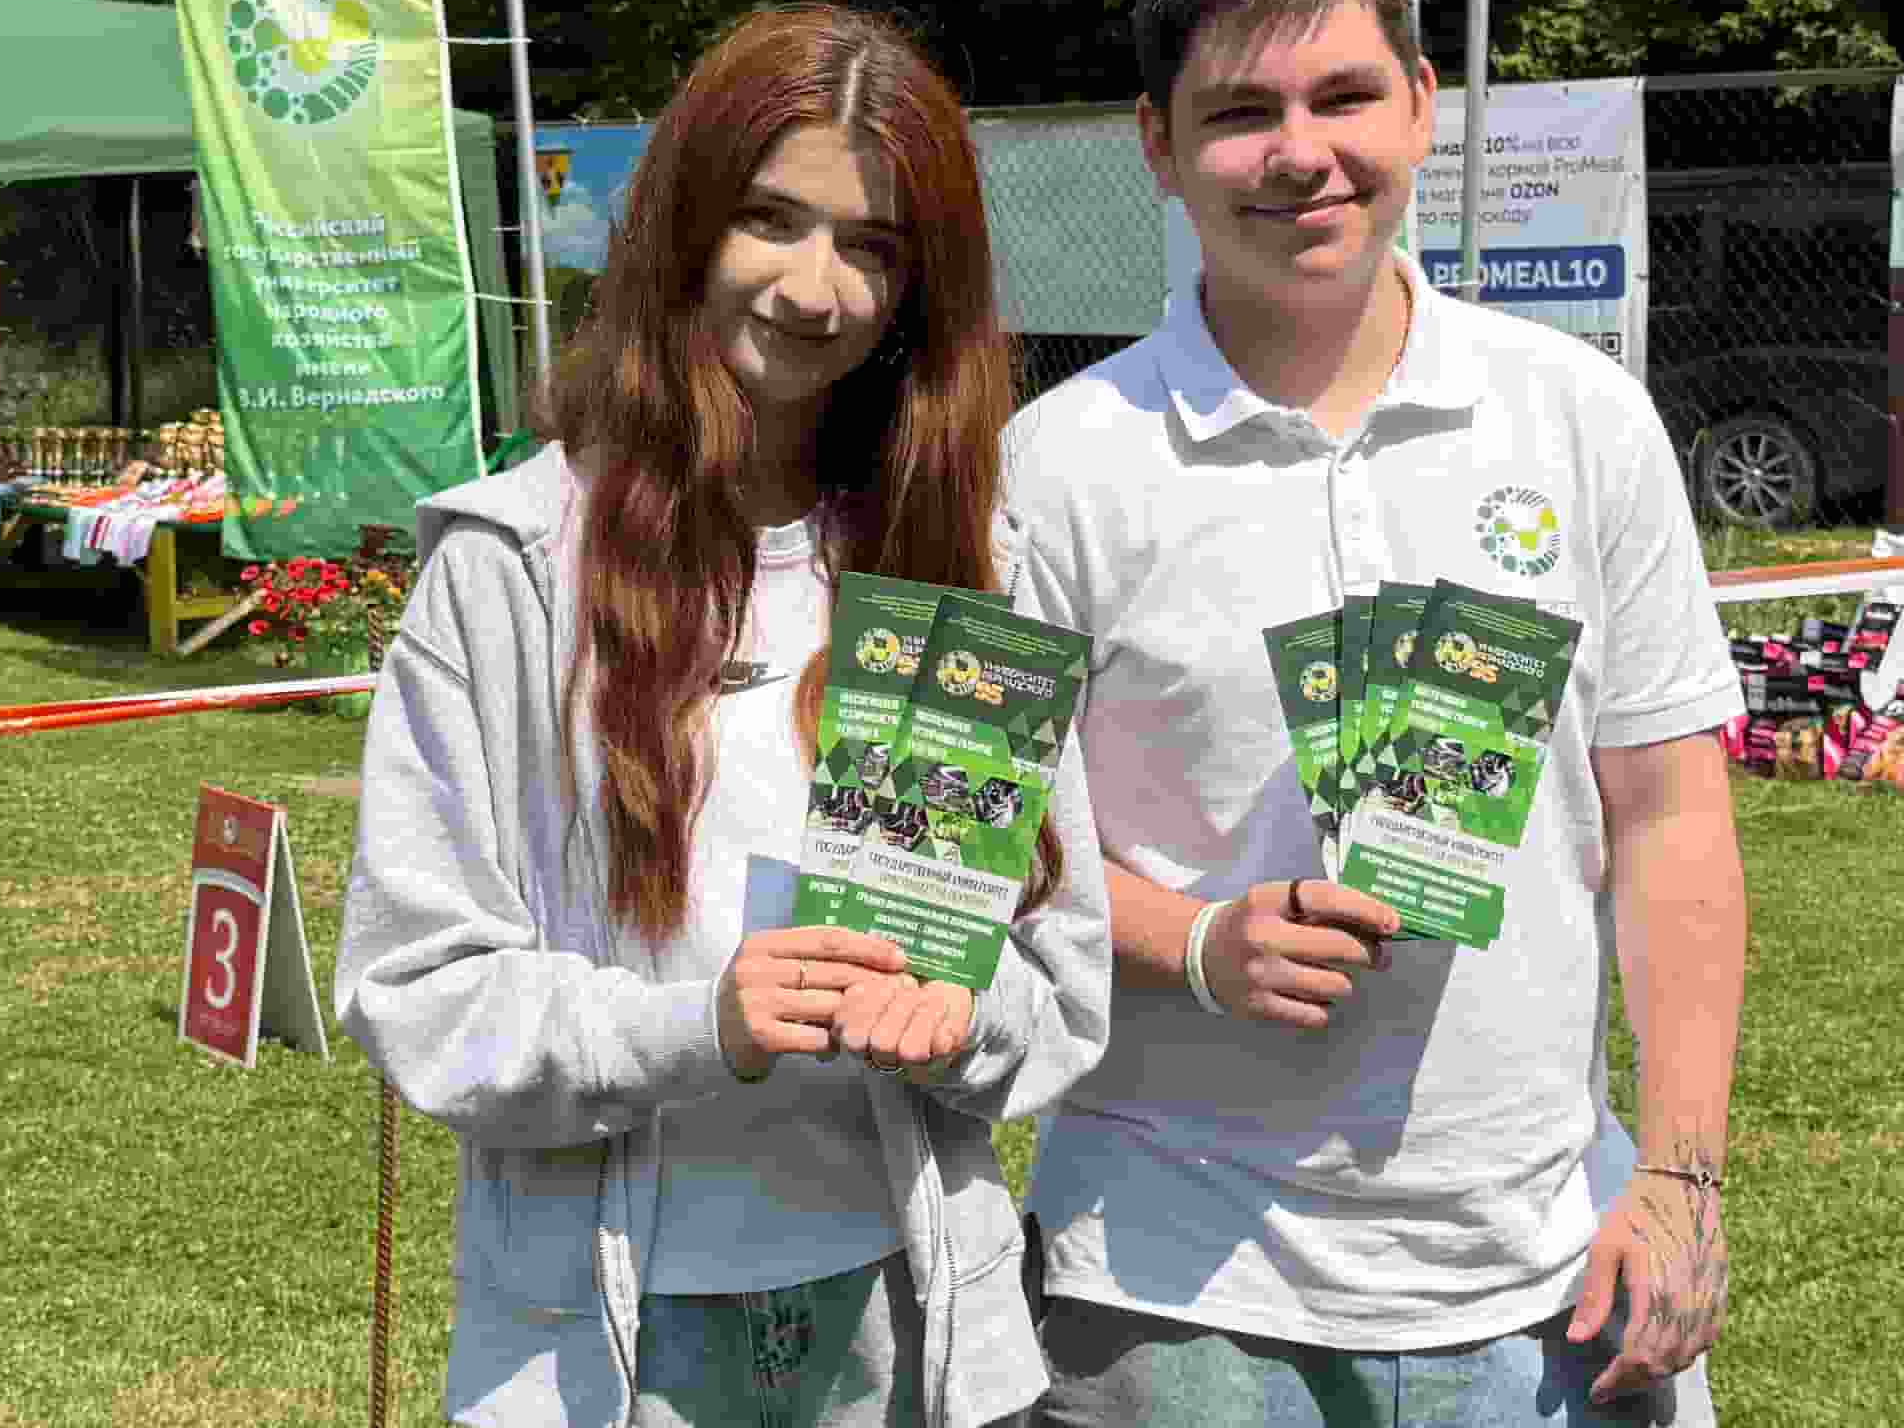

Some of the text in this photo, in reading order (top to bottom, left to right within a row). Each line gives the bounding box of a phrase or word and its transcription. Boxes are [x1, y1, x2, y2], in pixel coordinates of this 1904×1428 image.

[1510, 181, 1560, 200] OZON
[292, 384, 446, 412] Вернадского
[204, 908, 239, 1009] 3
